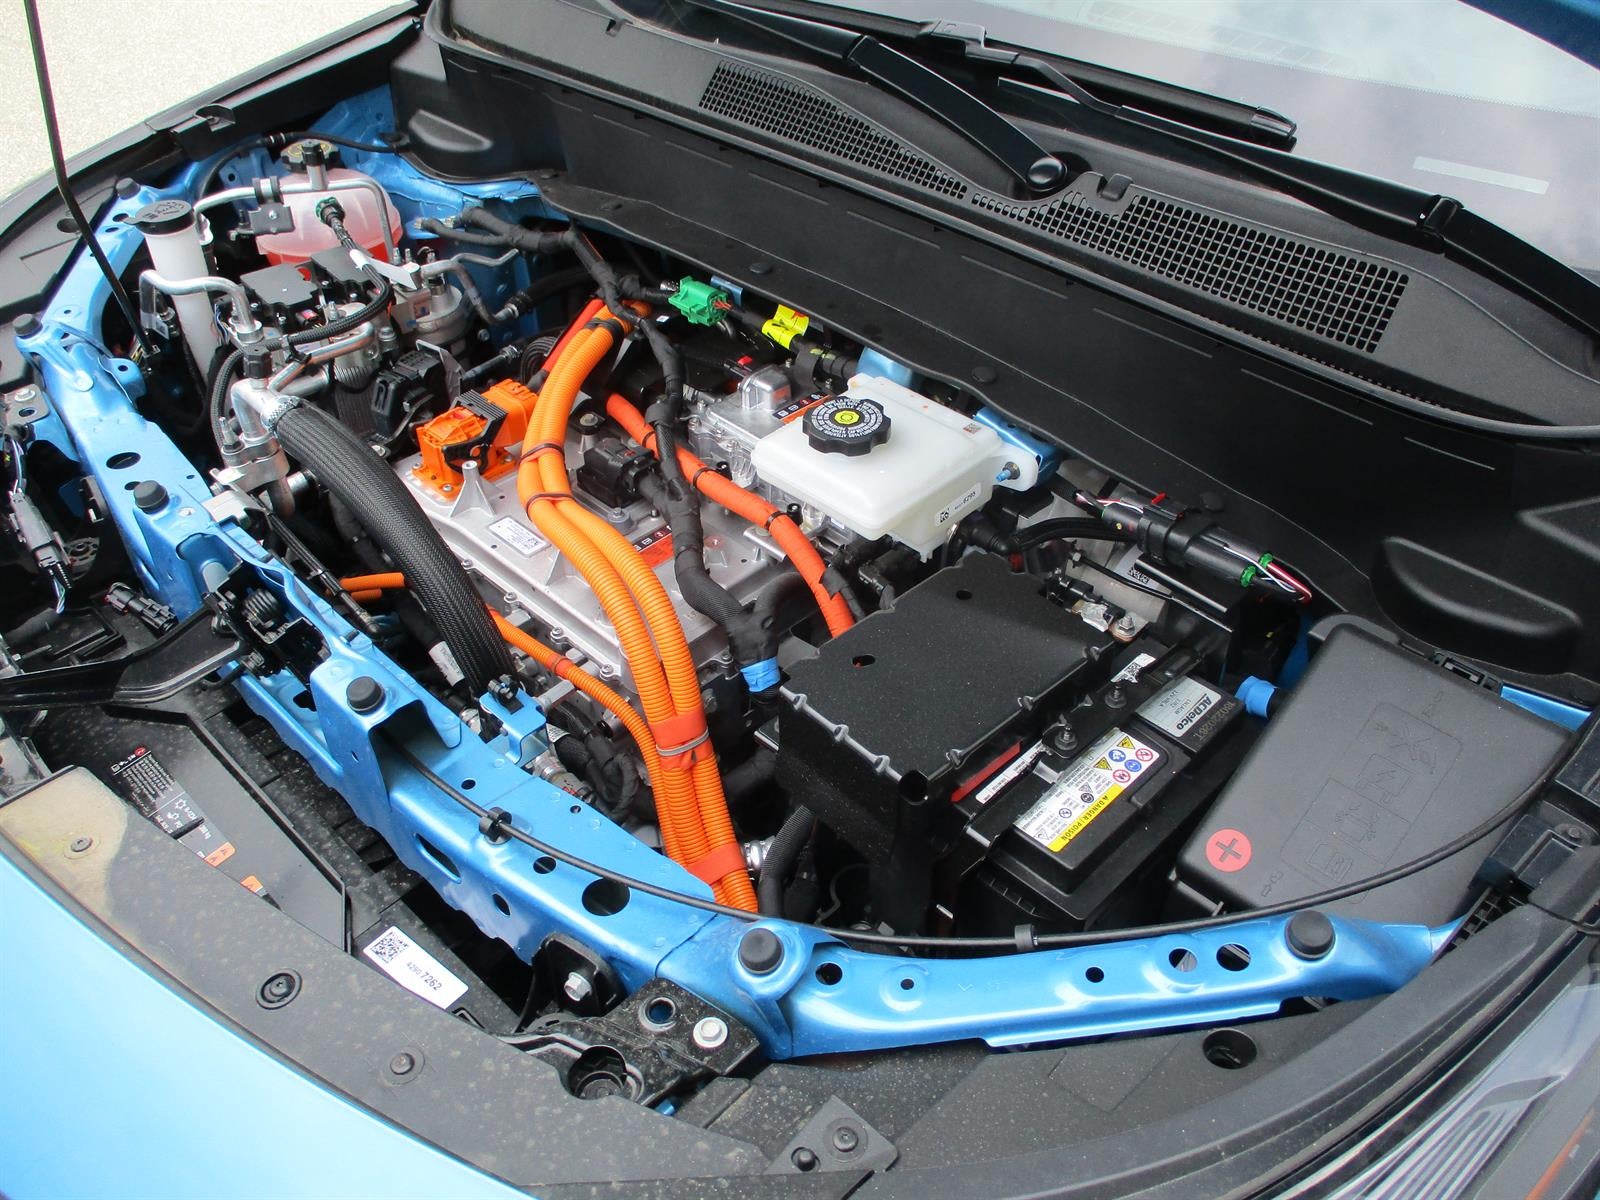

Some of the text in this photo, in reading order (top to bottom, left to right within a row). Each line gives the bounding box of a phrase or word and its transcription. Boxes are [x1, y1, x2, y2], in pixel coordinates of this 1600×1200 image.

[1176, 695, 1213, 730] ACDelco
[1083, 800, 1105, 820] DANGER
[1061, 822, 1082, 841] POISON
[421, 971, 443, 991] 7262
